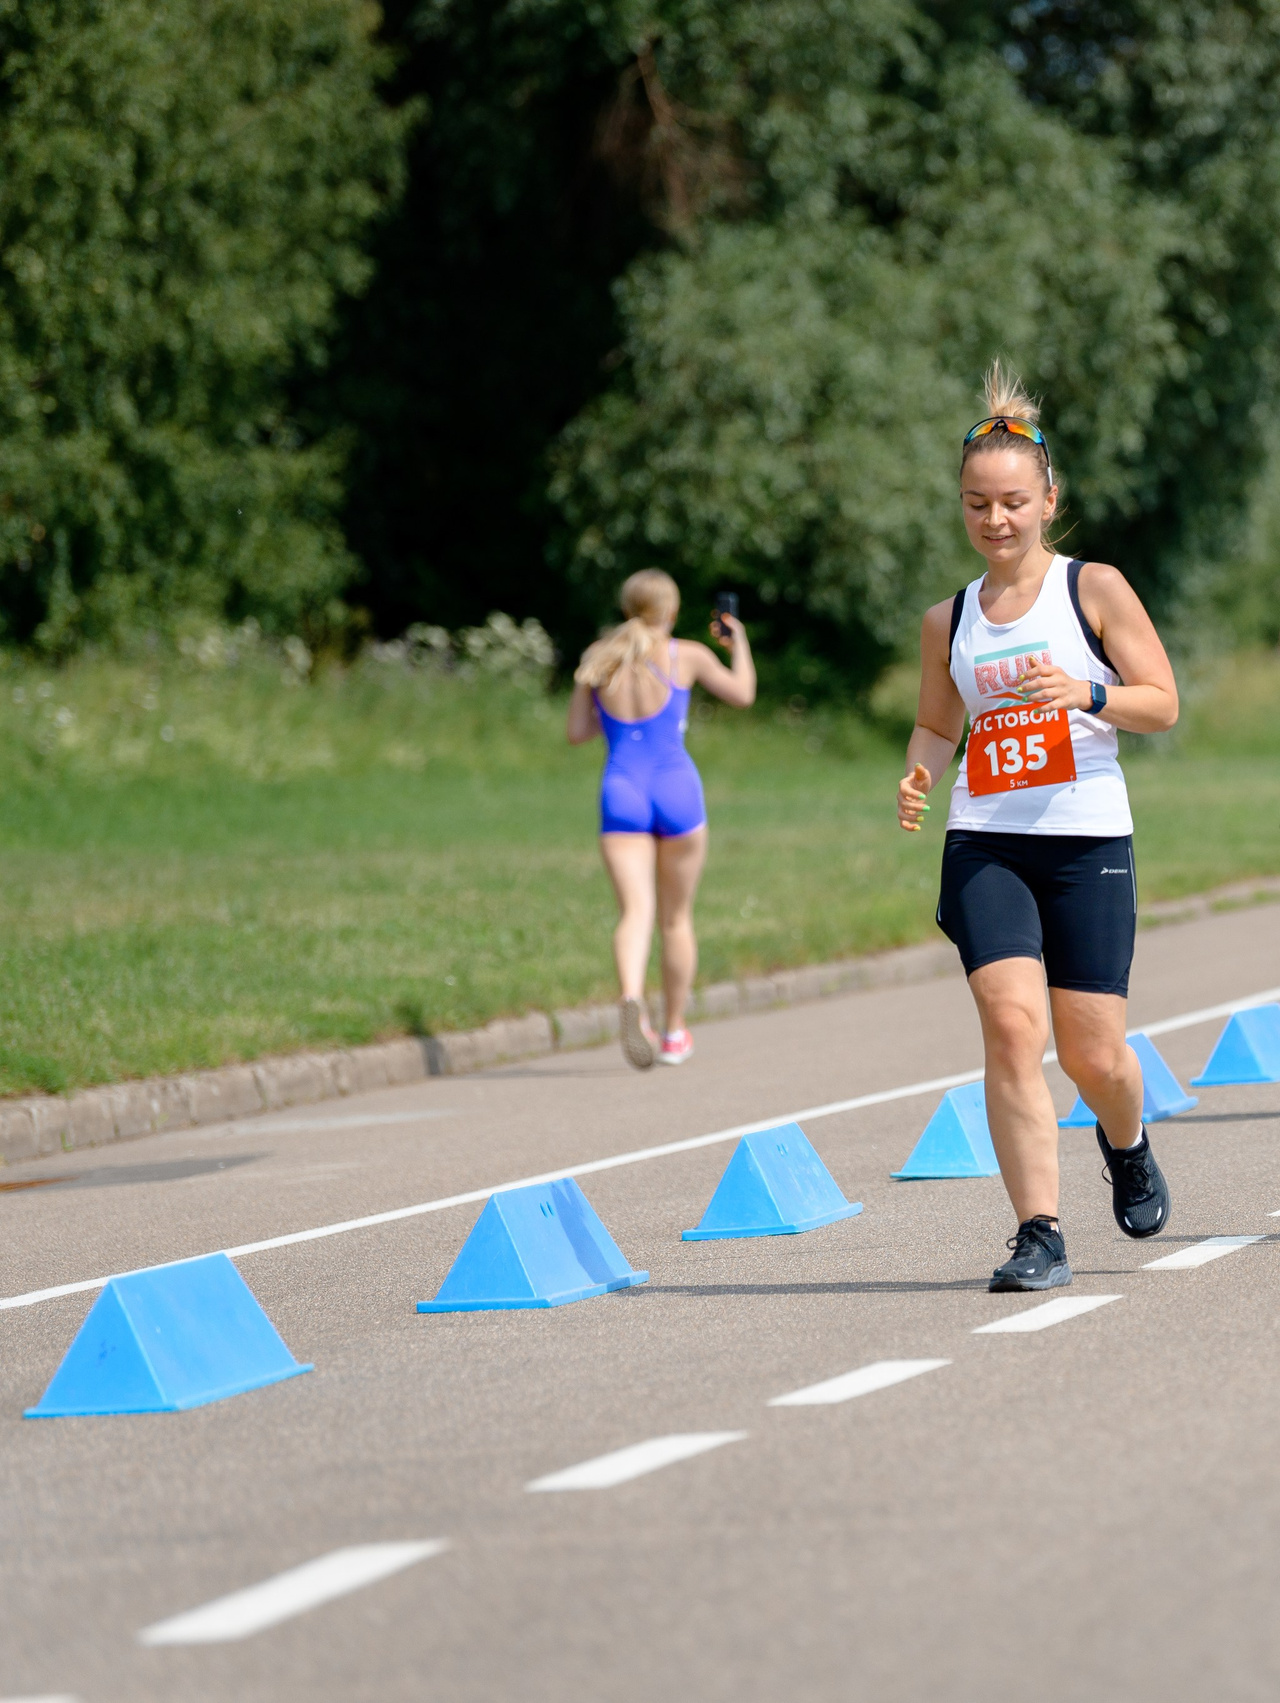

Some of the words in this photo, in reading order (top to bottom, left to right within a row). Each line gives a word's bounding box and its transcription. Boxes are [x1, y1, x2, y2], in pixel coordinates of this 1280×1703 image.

[973, 720, 981, 735] Я
[983, 716, 993, 732] С
[983, 733, 1048, 777] 135
[1009, 778, 1016, 788] 5
